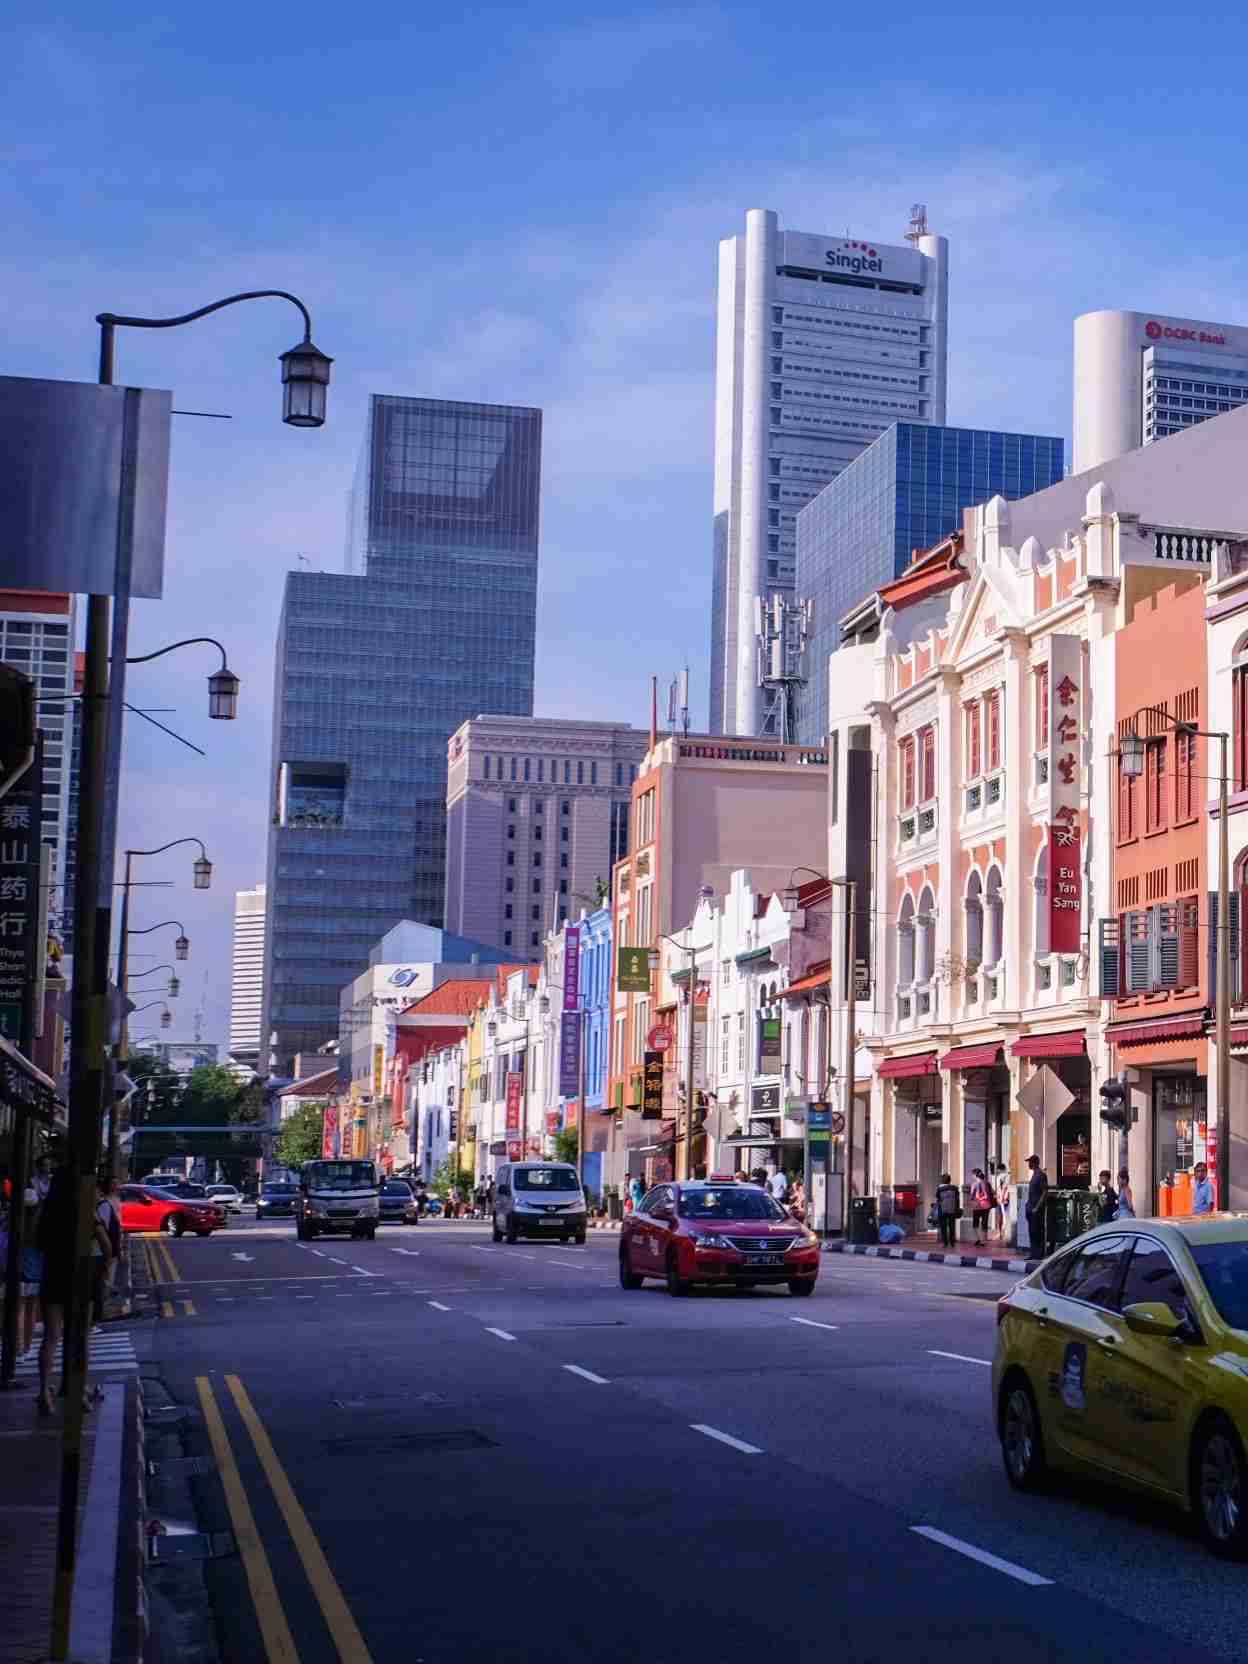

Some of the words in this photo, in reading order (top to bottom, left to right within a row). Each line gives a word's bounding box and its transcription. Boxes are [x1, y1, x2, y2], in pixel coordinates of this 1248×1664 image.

[825, 248, 883, 274] Singtel
[1164, 327, 1197, 341] OCBC
[1059, 868, 1074, 880] Eu
[1059, 881, 1077, 894] Yan
[1053, 896, 1081, 911] Sang
